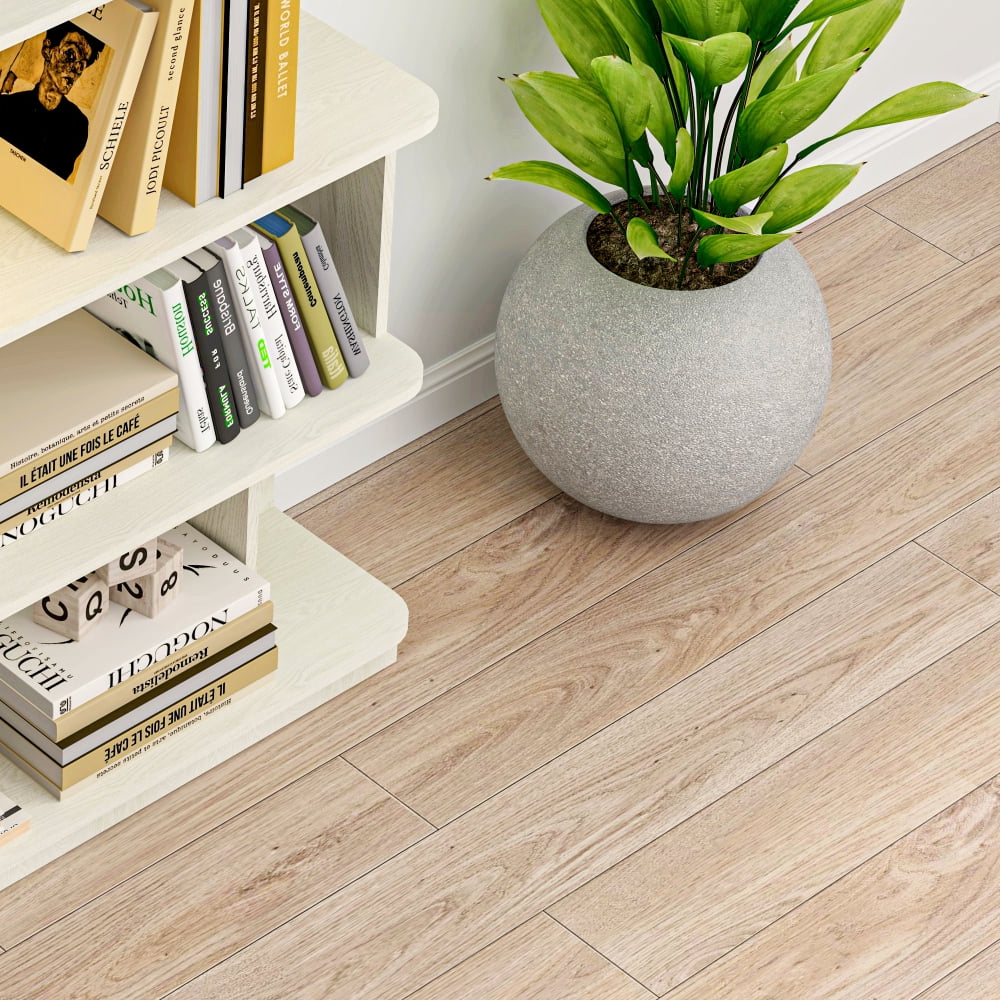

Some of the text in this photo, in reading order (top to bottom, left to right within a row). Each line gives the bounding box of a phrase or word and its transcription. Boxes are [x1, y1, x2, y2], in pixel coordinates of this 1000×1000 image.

[168, 7, 185, 80] second glance
[277, 52, 288, 98] BALLET
[100, 101, 129, 170] SCHIELE
[146, 106, 170, 196] JODI PICOULT
[10, 452, 40, 470] Histoire,
[40, 432, 76, 454] botanique,
[76, 424, 91, 436] arts
[100, 409, 120, 424] petits
[120, 396, 145, 409] secrets
[20, 413, 140, 488] IL ÉTAIT UNE FOIS LE CAFÉ
[1, 474, 118, 548] NOGUCHI
[119, 547, 148, 571] S
[160, 571, 178, 596] 8
[42, 596, 68, 622] C
[86, 590, 103, 620] Q
[108, 608, 230, 688] NOGUCHI
[132, 646, 209, 695] Remodelista
[104, 682, 226, 764] IL ÉTAIT UNE FOIS LE CAFÉ
